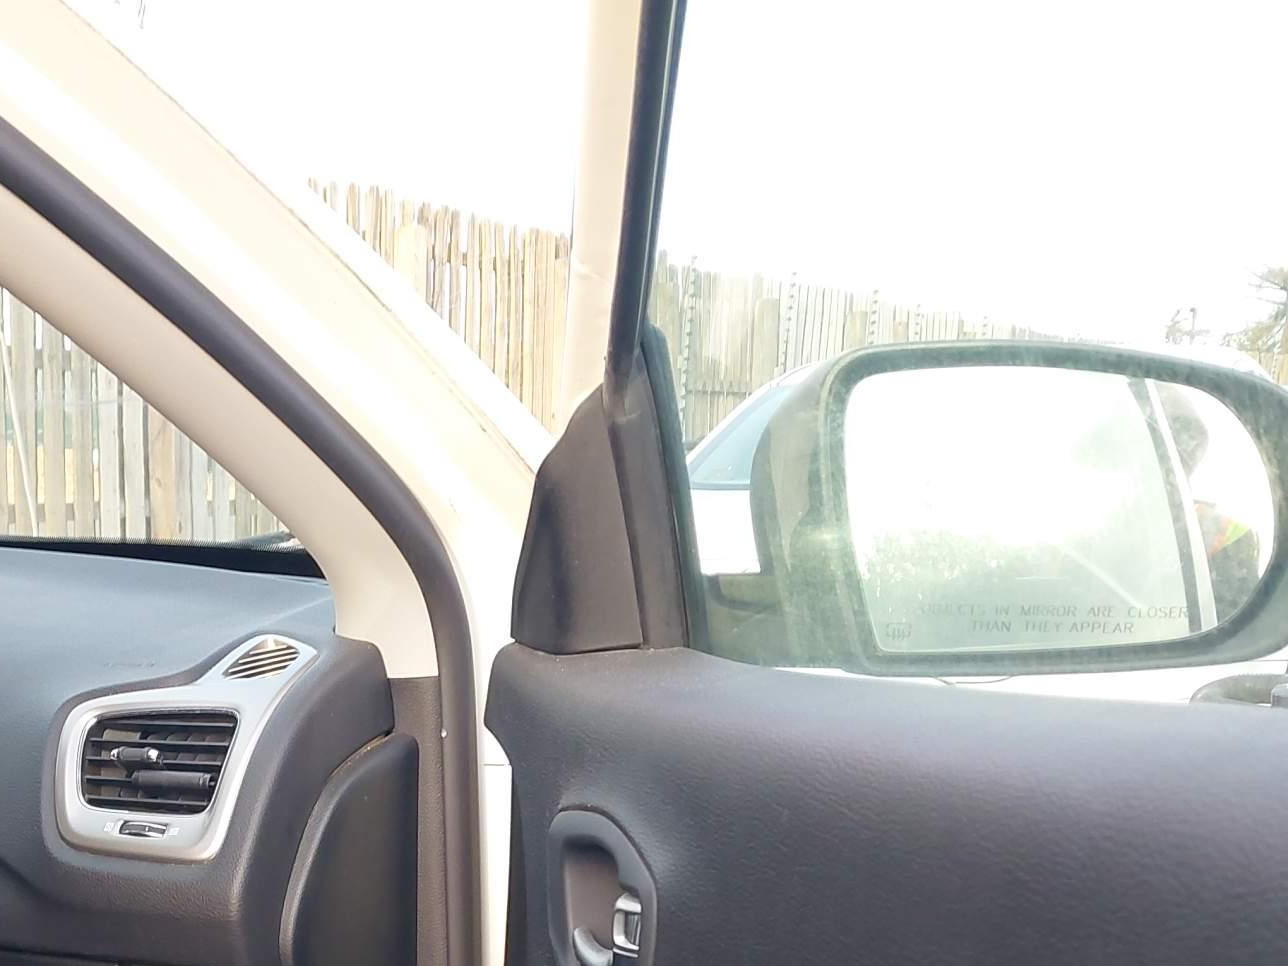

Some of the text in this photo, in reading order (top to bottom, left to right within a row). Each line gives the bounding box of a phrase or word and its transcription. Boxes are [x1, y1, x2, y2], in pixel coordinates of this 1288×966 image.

[995, 604, 1011, 616] IN
[1020, 604, 1078, 617] MIRROR
[1087, 605, 1115, 618] ARE
[1128, 605, 1190, 619] CLOSER
[971, 619, 1135, 634] THAN THEY APPEAR
